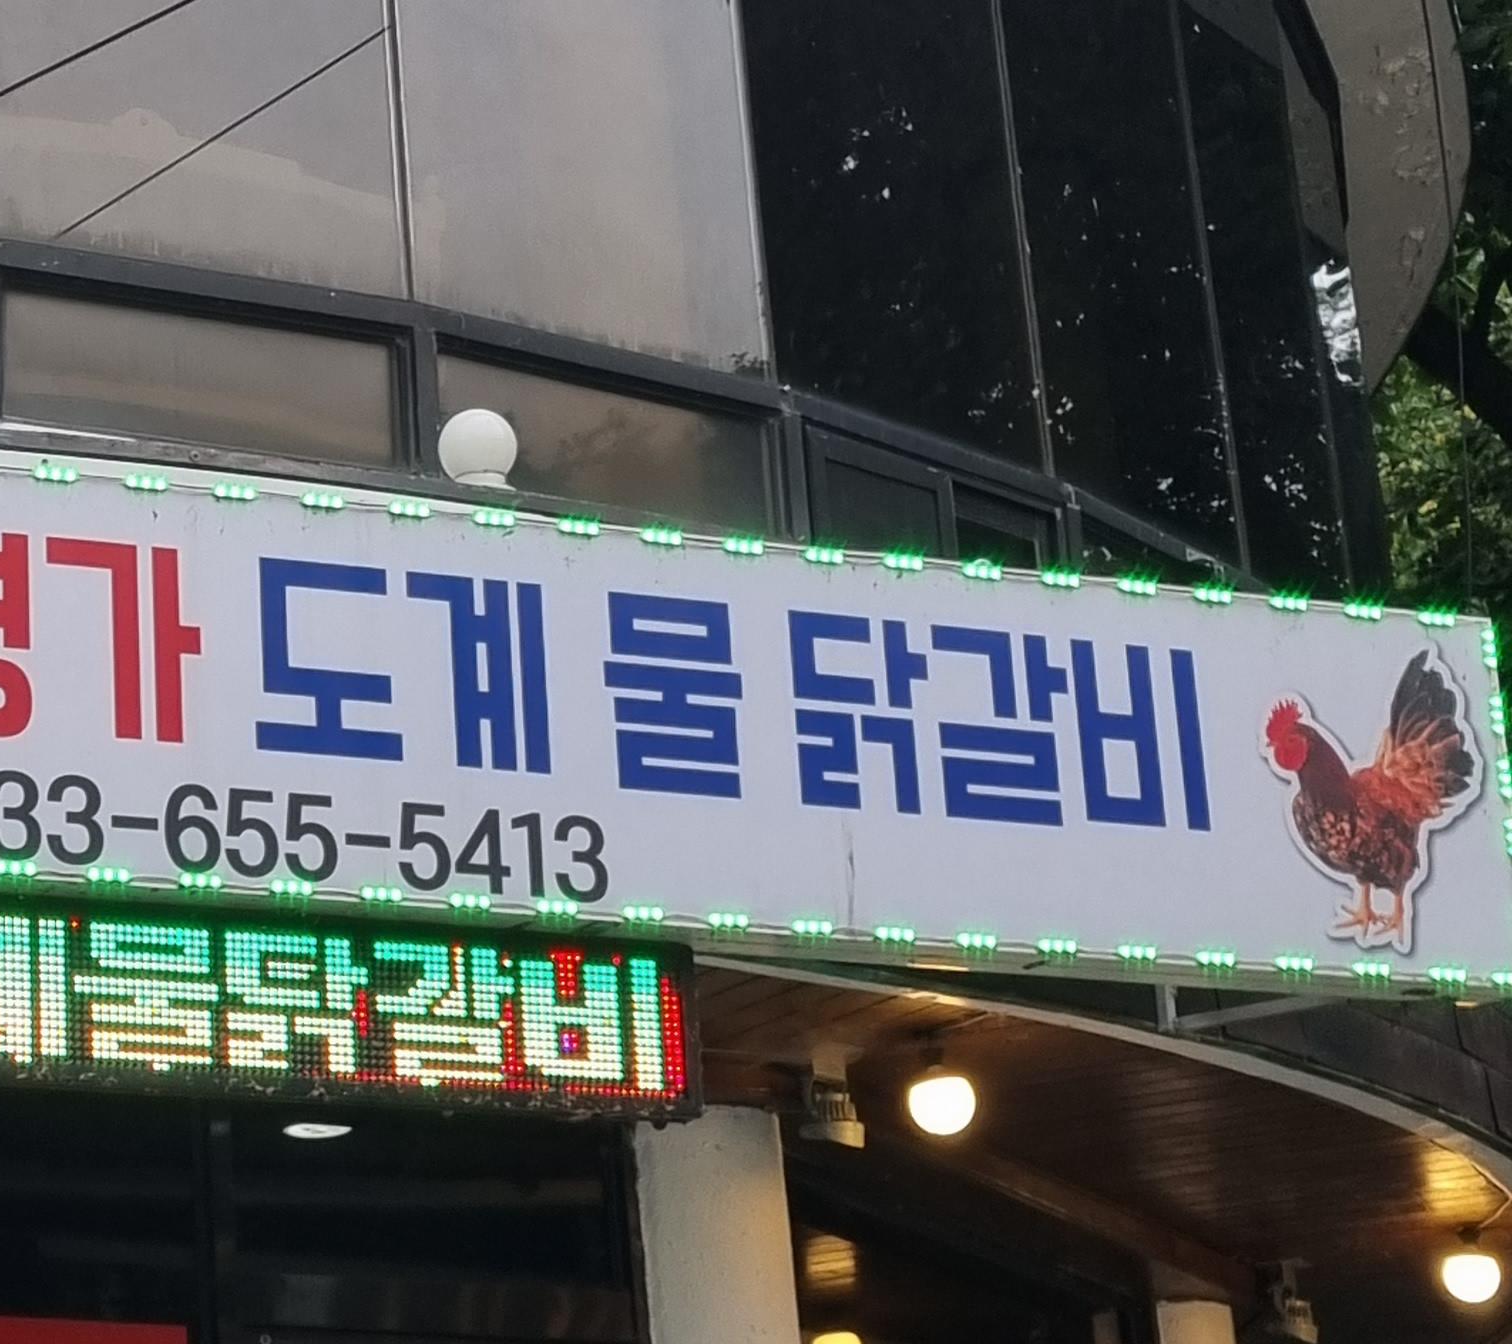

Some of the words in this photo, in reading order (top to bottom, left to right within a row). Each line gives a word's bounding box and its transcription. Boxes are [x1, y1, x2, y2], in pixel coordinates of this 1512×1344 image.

[255, 557, 551, 775] 도계
[603, 591, 743, 798] 물
[788, 610, 1210, 831] 닭갈비
